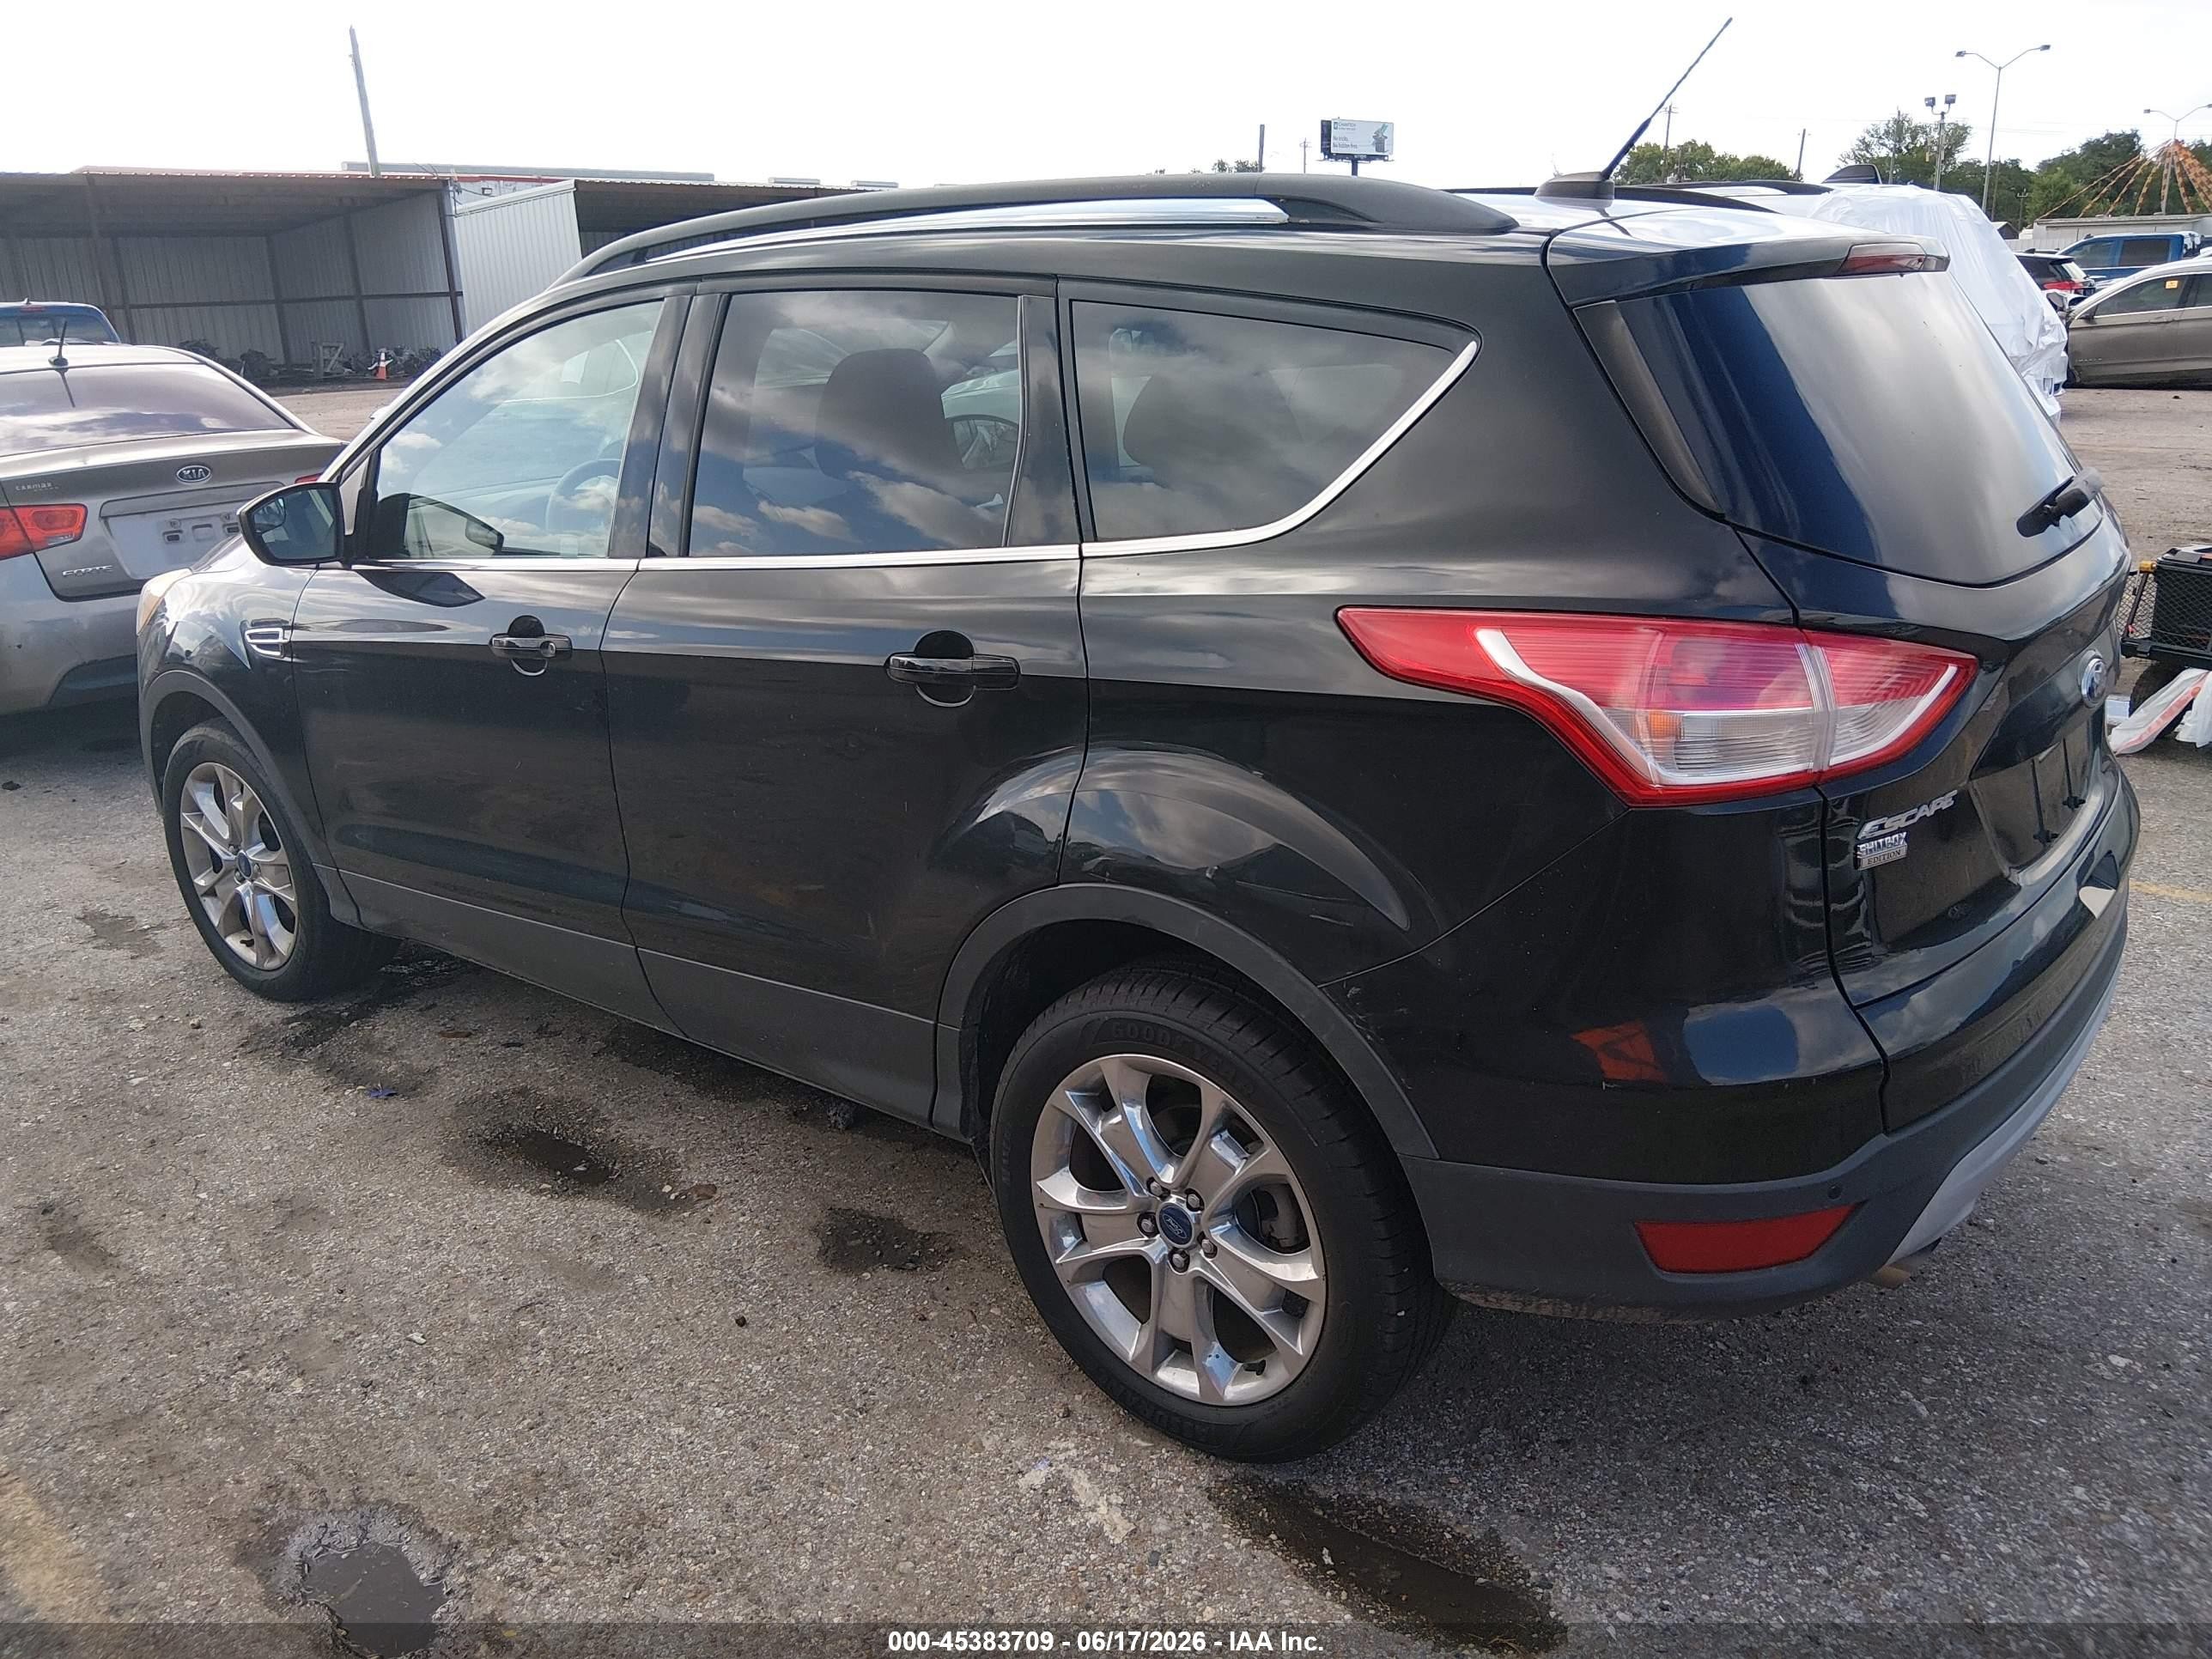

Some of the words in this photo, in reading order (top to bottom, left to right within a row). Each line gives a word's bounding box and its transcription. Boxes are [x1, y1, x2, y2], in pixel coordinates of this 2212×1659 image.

[182, 468, 206, 479] KIA
[1857, 789, 1958, 840] ESCAPE
[1867, 848, 1901, 865] EDITION
